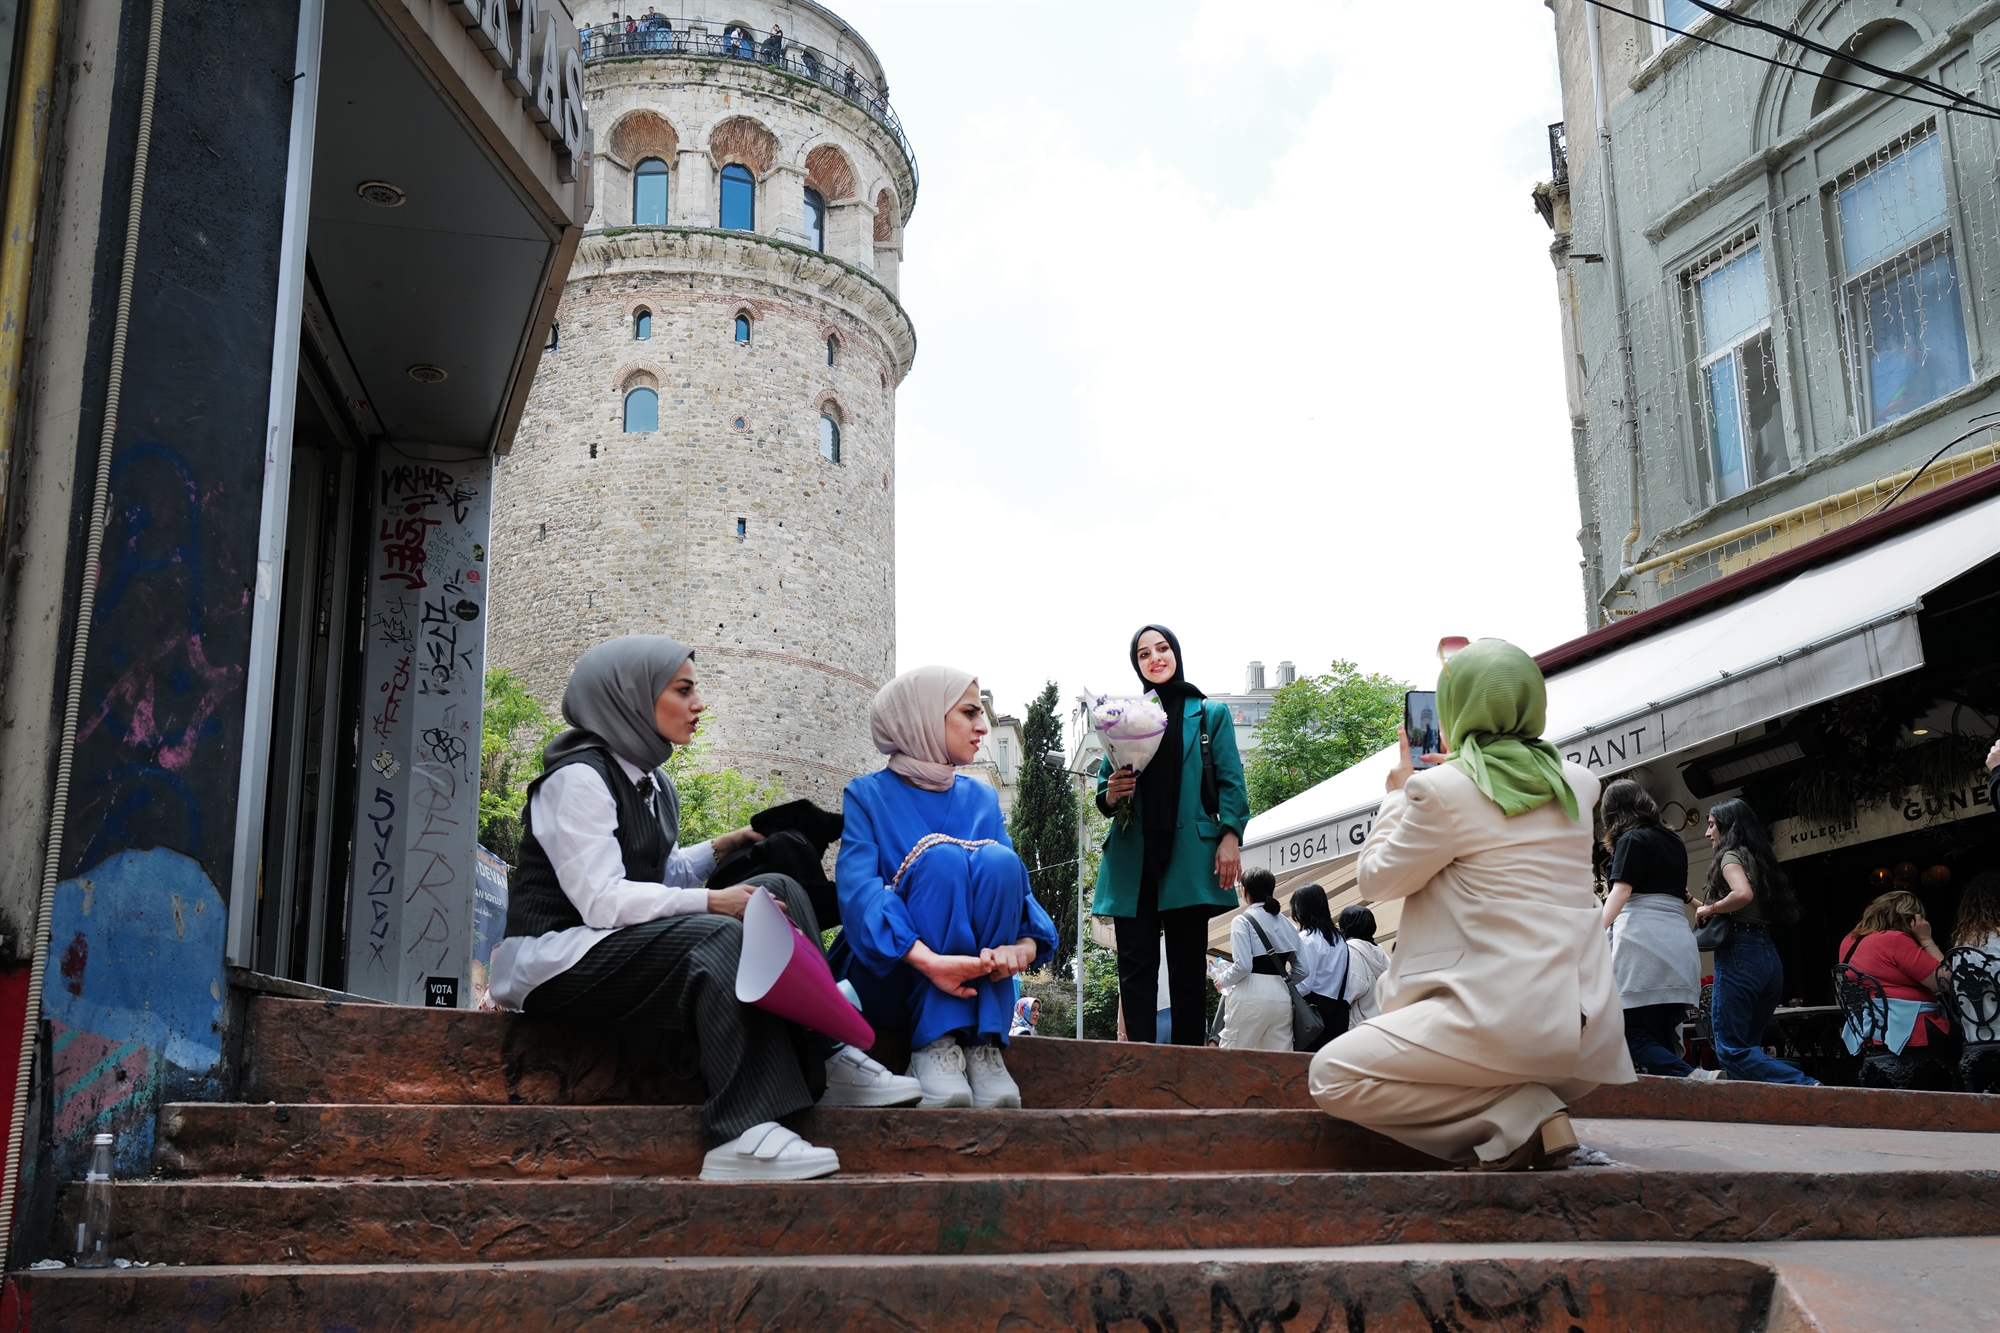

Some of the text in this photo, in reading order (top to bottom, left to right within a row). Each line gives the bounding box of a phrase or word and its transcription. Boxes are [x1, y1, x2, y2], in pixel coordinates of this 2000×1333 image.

[1791, 816, 1858, 844] KULEDİBİ
[1280, 833, 1328, 866] 1964
[430, 984, 453, 994] VOTA
[435, 996, 447, 1006] AL
